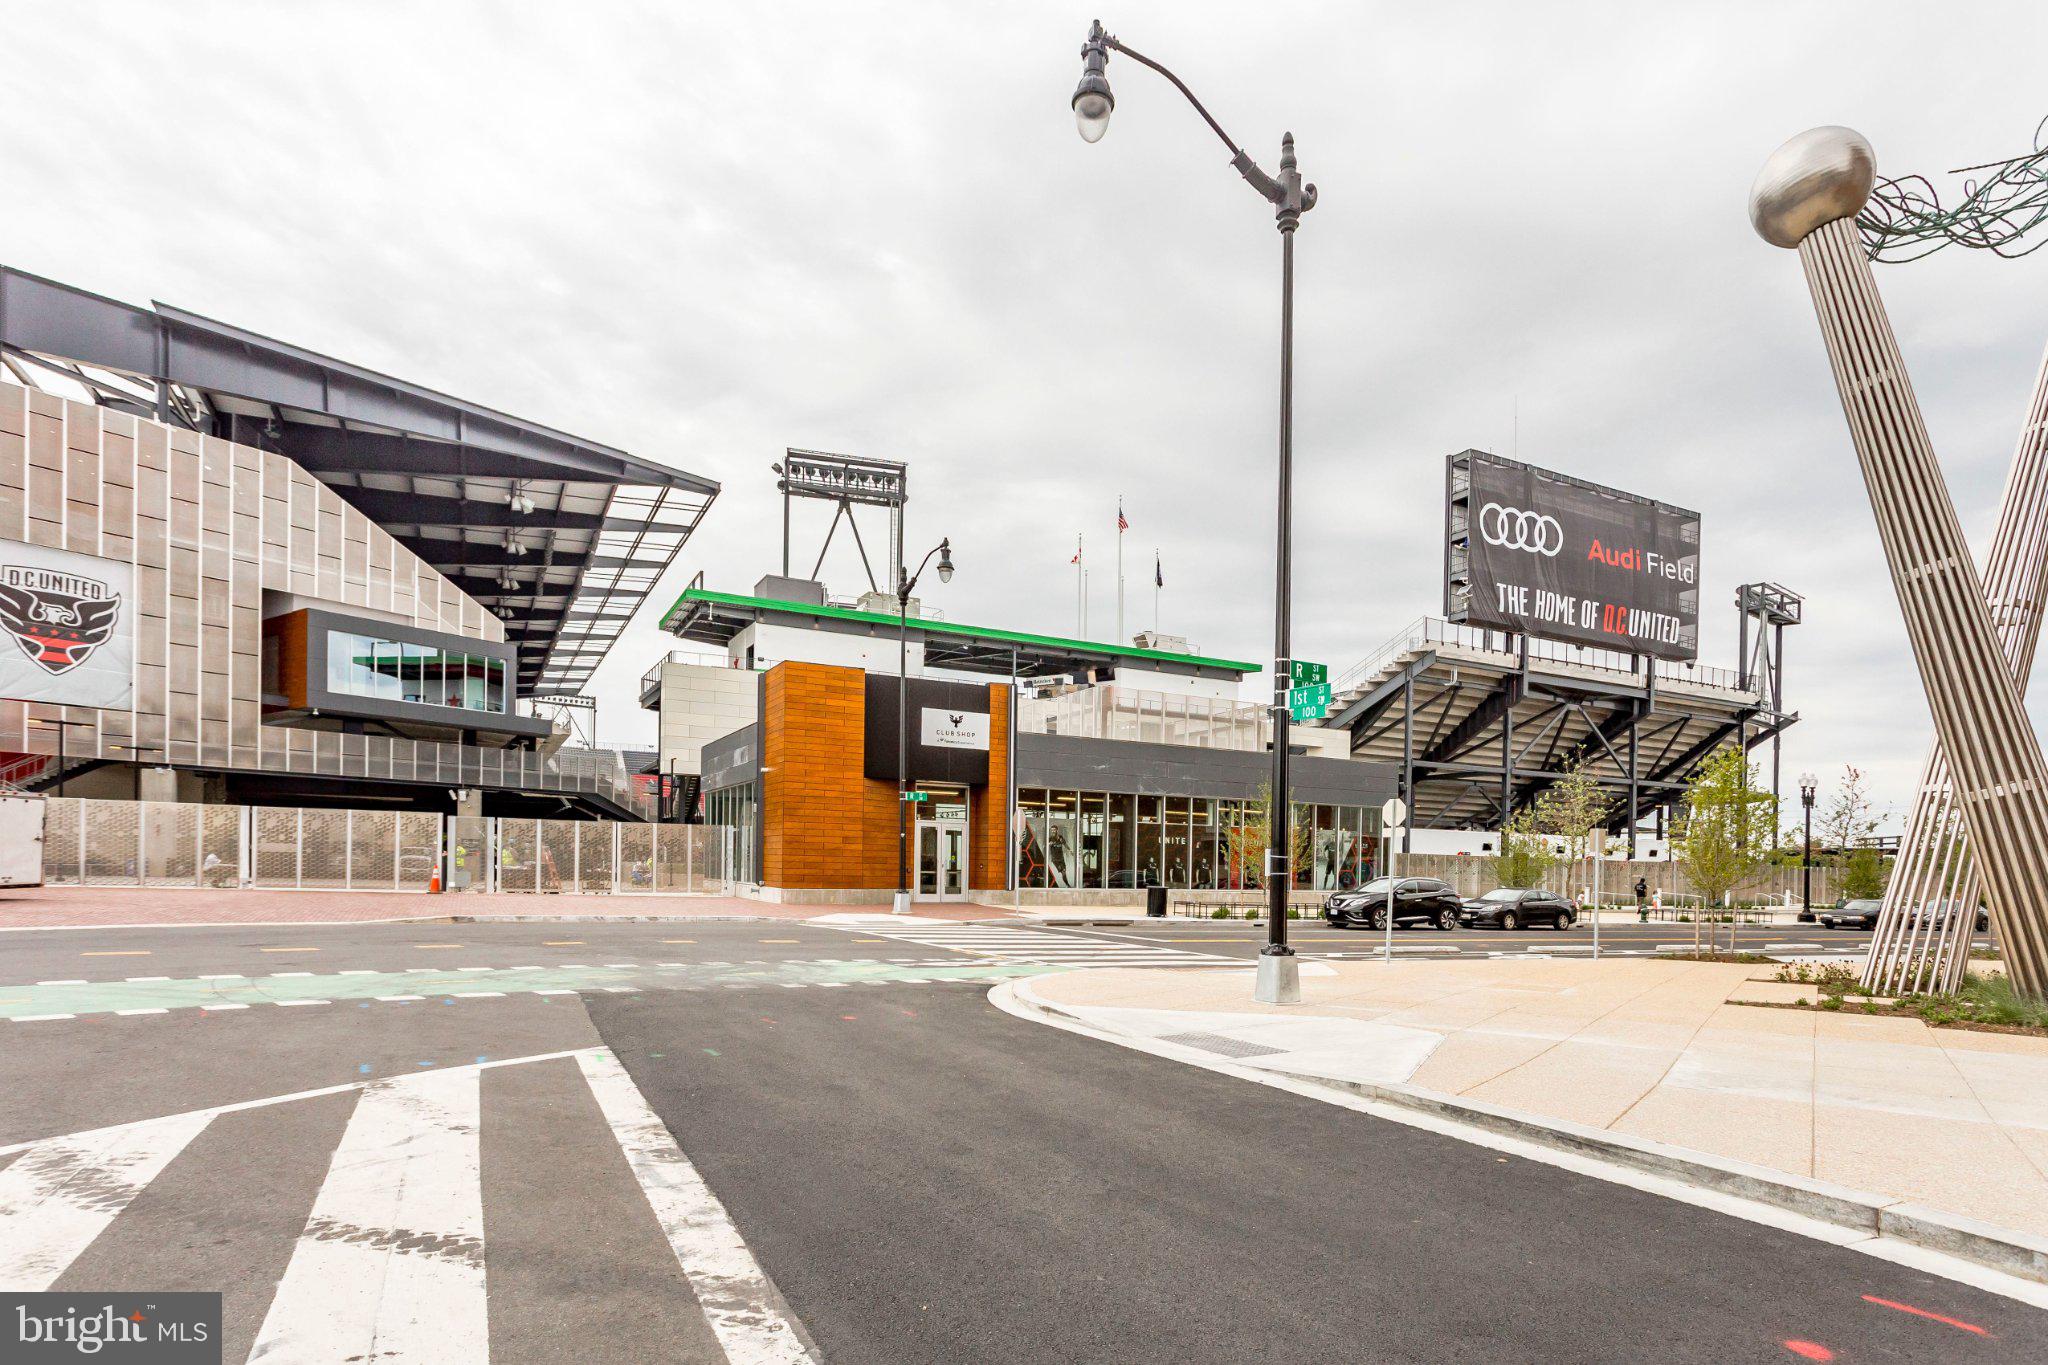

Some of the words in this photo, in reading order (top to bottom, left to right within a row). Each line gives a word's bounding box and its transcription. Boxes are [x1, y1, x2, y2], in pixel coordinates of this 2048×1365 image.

[1588, 539, 1641, 571] Audi
[1646, 552, 1694, 585] Field
[1496, 582, 1529, 616] THE
[1535, 590, 1576, 626] HOME
[1581, 599, 1599, 630] OF
[1296, 663, 1303, 678] R
[1294, 690, 1307, 705] 1st
[1302, 706, 1316, 717] 100
